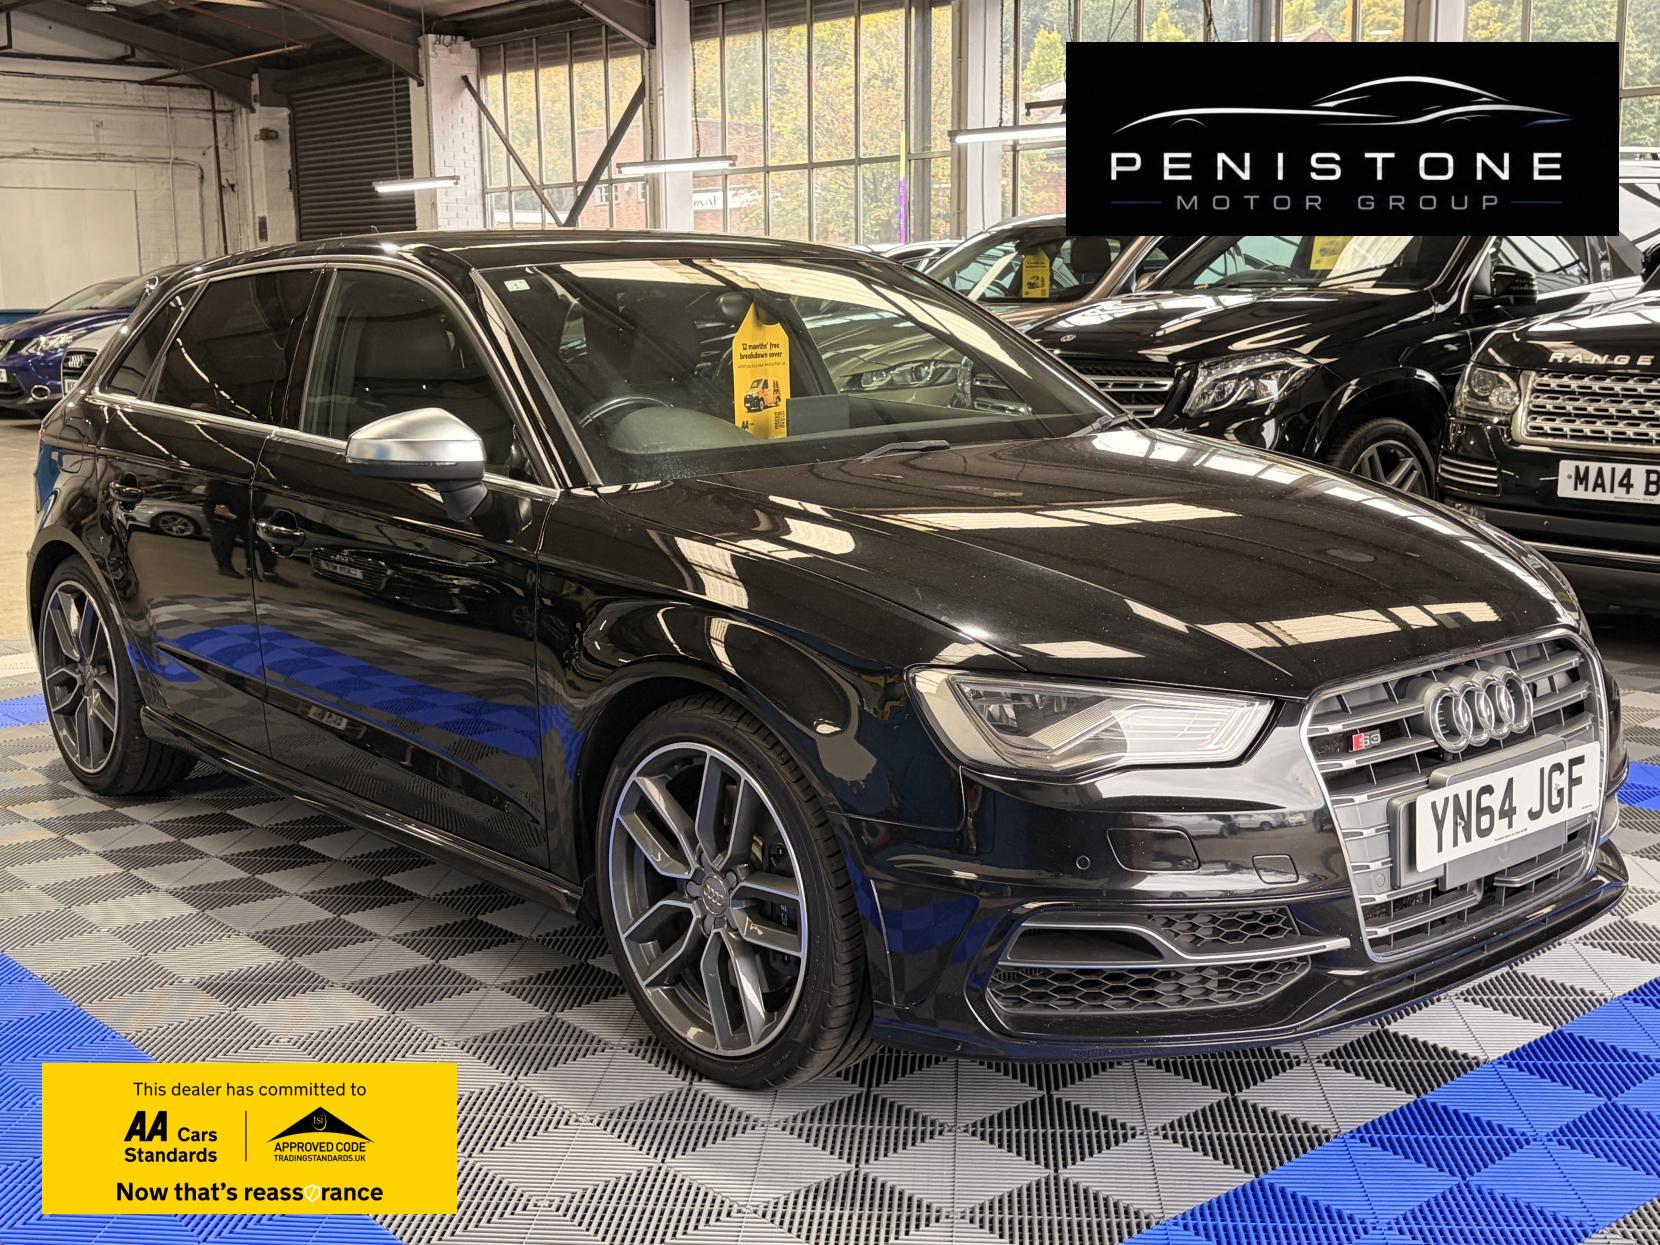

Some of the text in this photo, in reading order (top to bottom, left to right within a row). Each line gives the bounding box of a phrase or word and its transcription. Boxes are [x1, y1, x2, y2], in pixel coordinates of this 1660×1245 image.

[769, 341, 780, 350] free
[740, 351, 768, 360] breakdown
[1548, 352, 1655, 366] RANGE
[1573, 465, 1660, 496] MA14 B
[1358, 732, 1381, 748] S3
[1430, 754, 1586, 854] YN64 JGF
